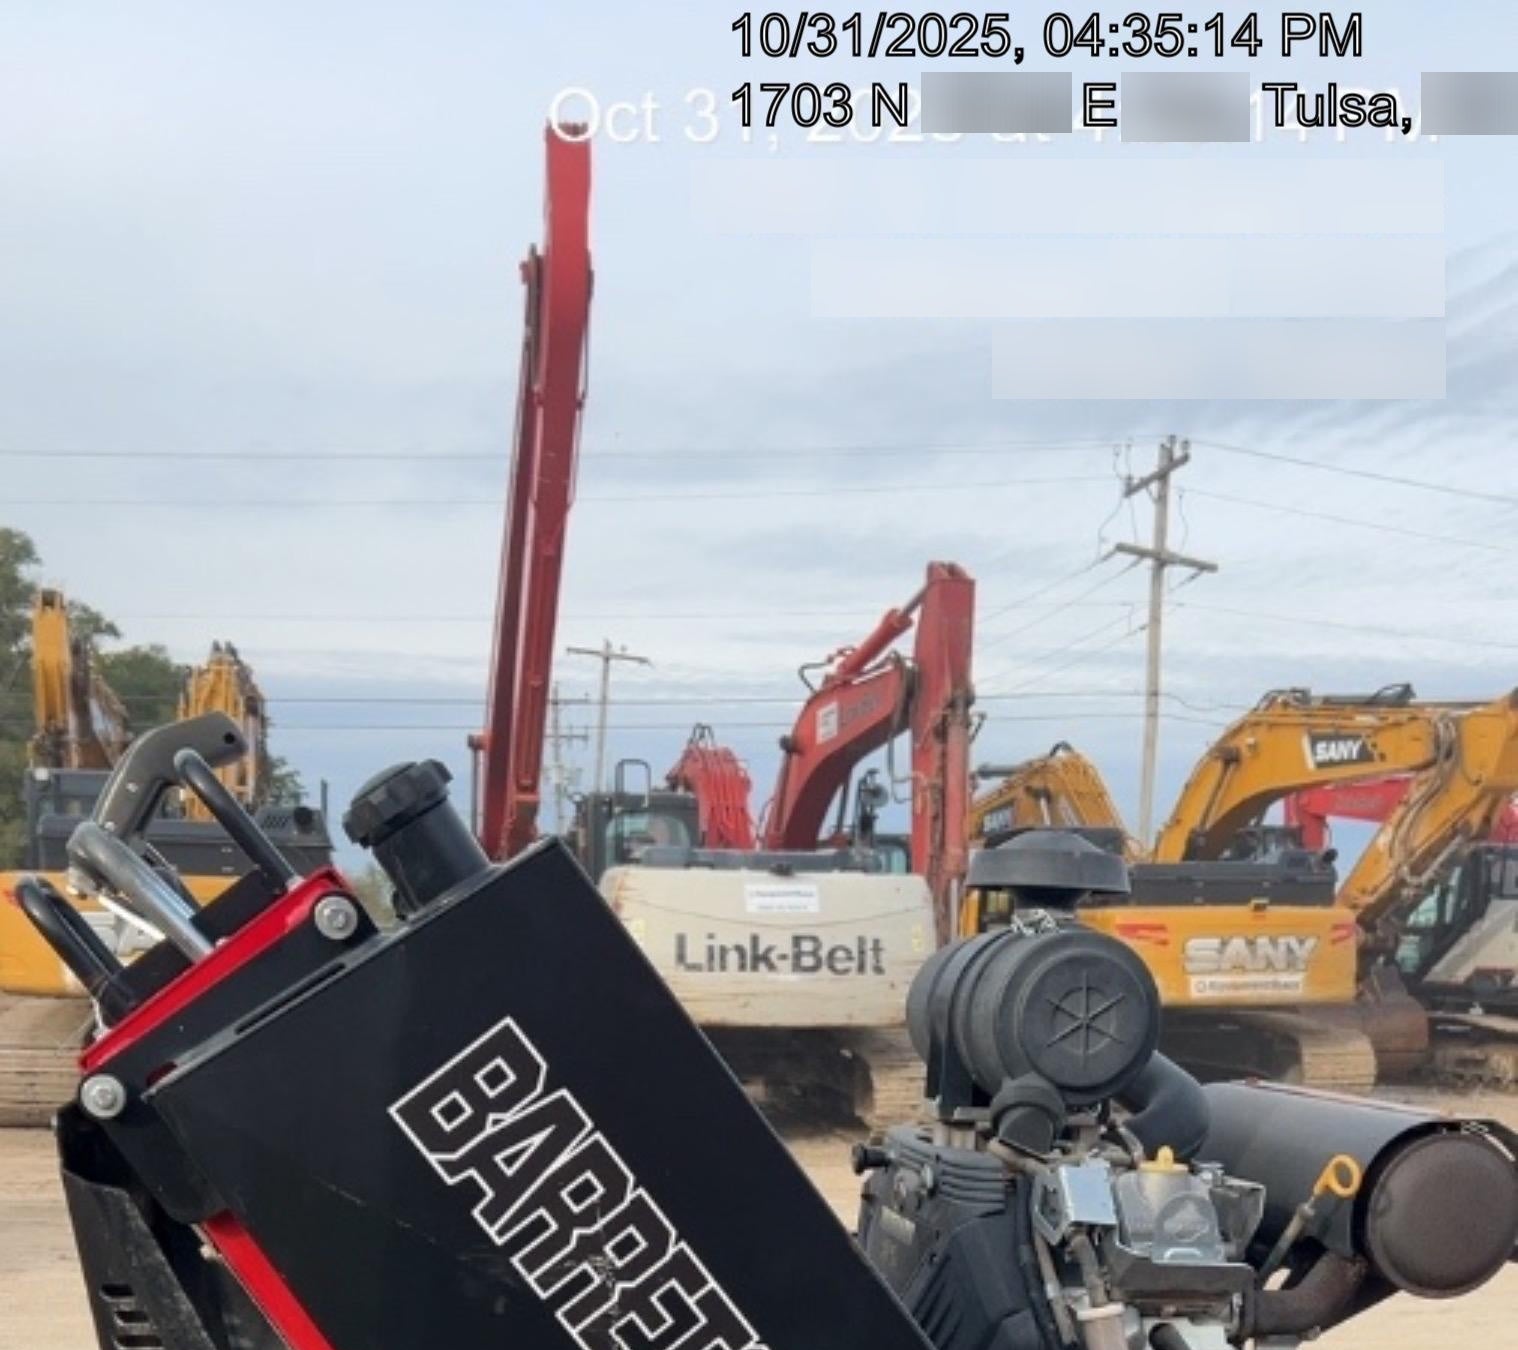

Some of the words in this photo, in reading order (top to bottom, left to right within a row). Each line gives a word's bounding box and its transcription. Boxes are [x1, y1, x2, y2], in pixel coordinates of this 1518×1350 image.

[1315, 738, 1362, 763] SANY
[674, 932, 886, 976] Link-Belt
[1183, 934, 1319, 973] SANY
